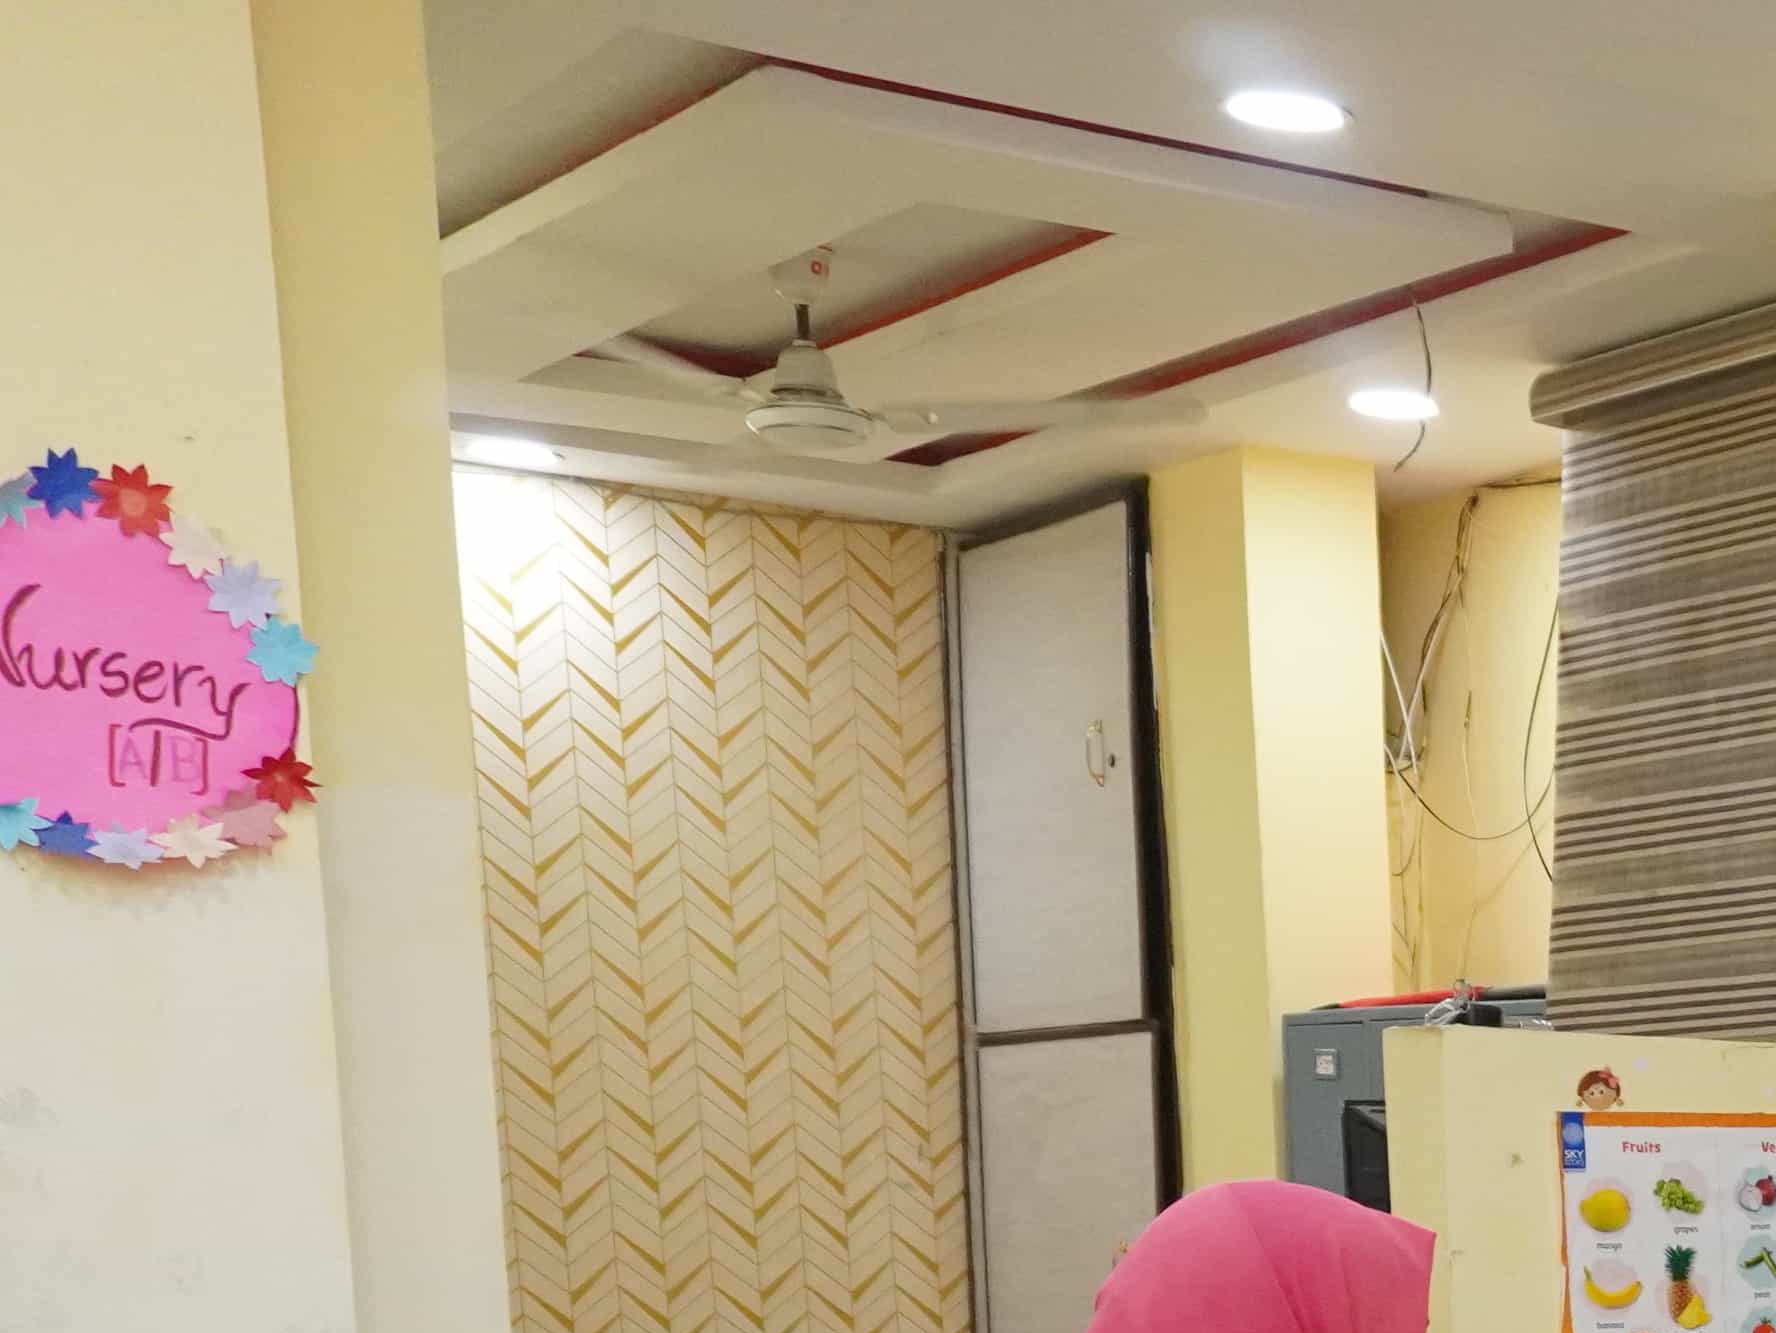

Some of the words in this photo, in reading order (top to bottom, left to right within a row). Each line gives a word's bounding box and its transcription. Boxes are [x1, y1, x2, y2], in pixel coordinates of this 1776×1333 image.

[0, 584, 250, 739] Nursery
[1622, 1141, 1661, 1153] Fruits
[1564, 1150, 1584, 1159] SKY
